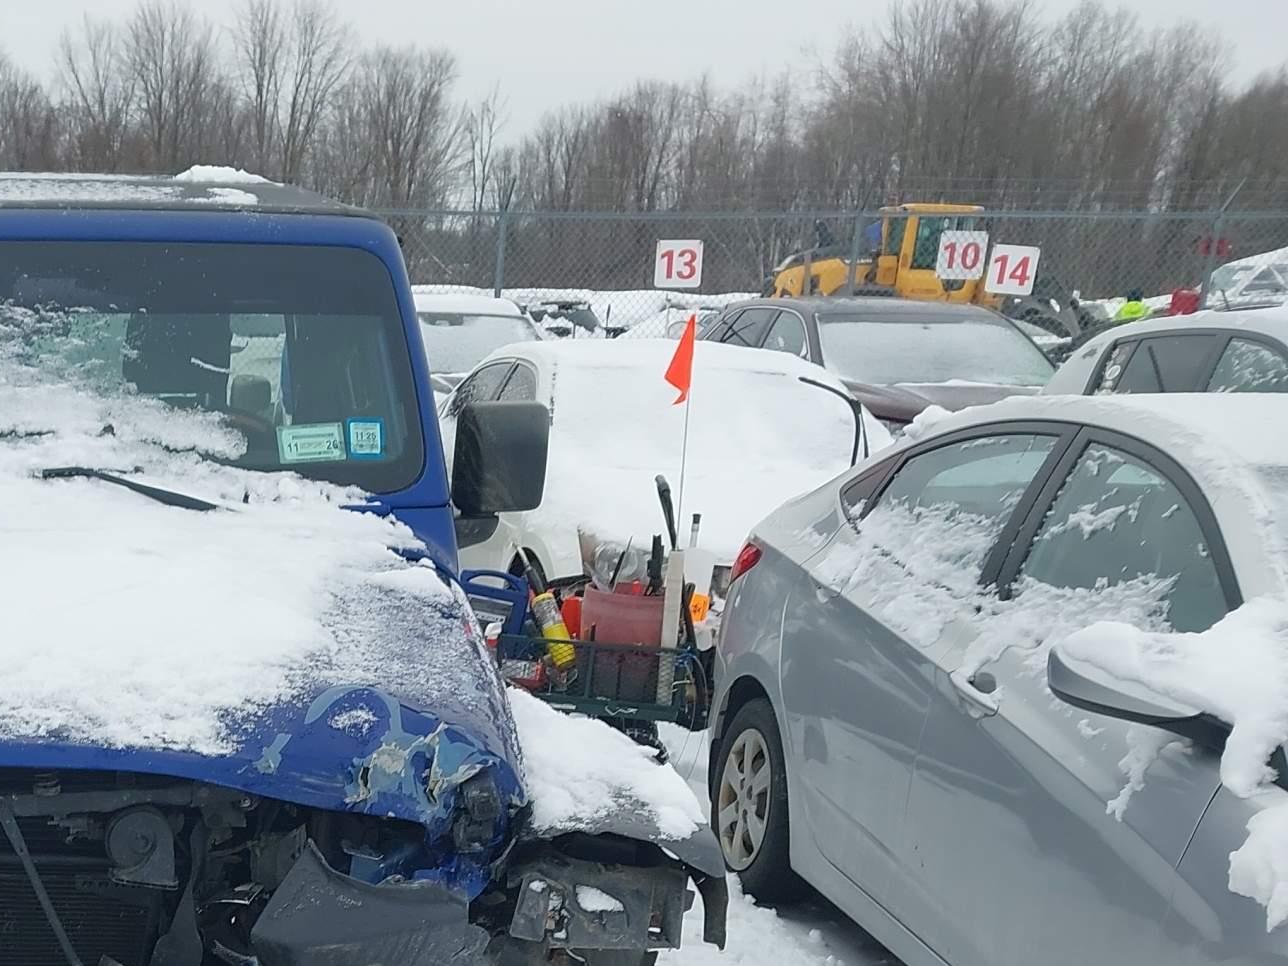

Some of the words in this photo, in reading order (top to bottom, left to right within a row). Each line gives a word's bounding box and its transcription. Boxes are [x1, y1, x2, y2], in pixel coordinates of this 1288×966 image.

[660, 247, 698, 280] 13
[942, 241, 981, 271] 10
[992, 254, 1031, 287] 14
